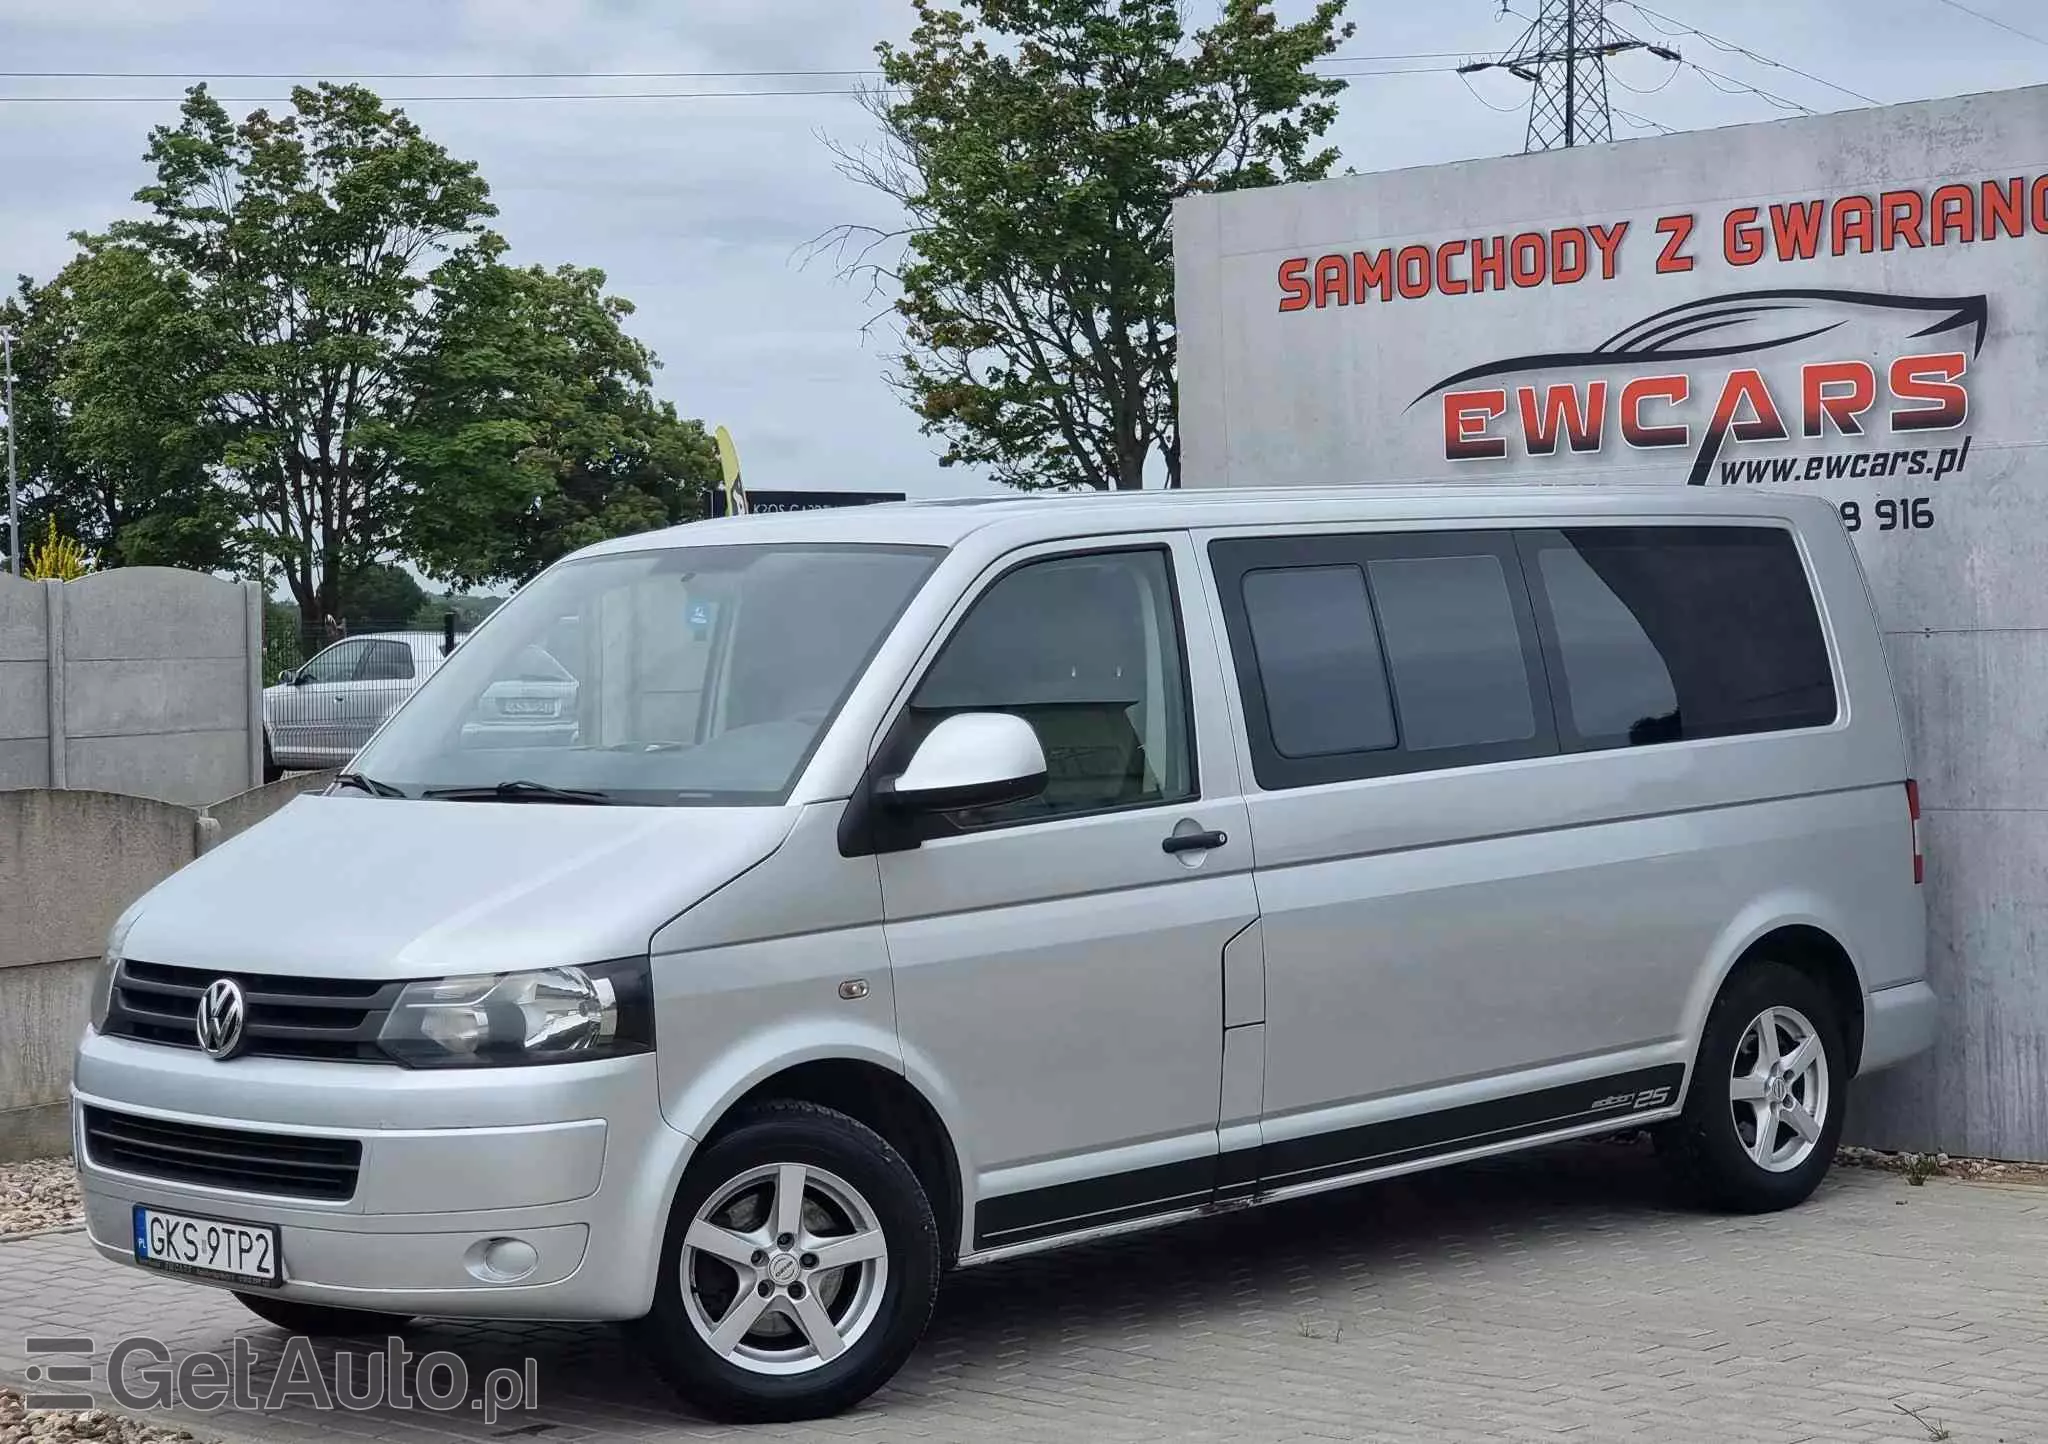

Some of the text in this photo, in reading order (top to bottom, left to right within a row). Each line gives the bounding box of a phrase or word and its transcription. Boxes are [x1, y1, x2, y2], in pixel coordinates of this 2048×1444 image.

[1278, 221, 1630, 313] SAMOCHODY
[1655, 214, 1694, 274] Z
[1443, 351, 1970, 486] EWCARS
[1720, 435, 1972, 486] www.ewcars.pl
[1875, 497, 1935, 531] 916
[138, 1238, 147, 1249] PL
[150, 1216, 199, 1262] GKS
[207, 1226, 271, 1273] 9TP2
